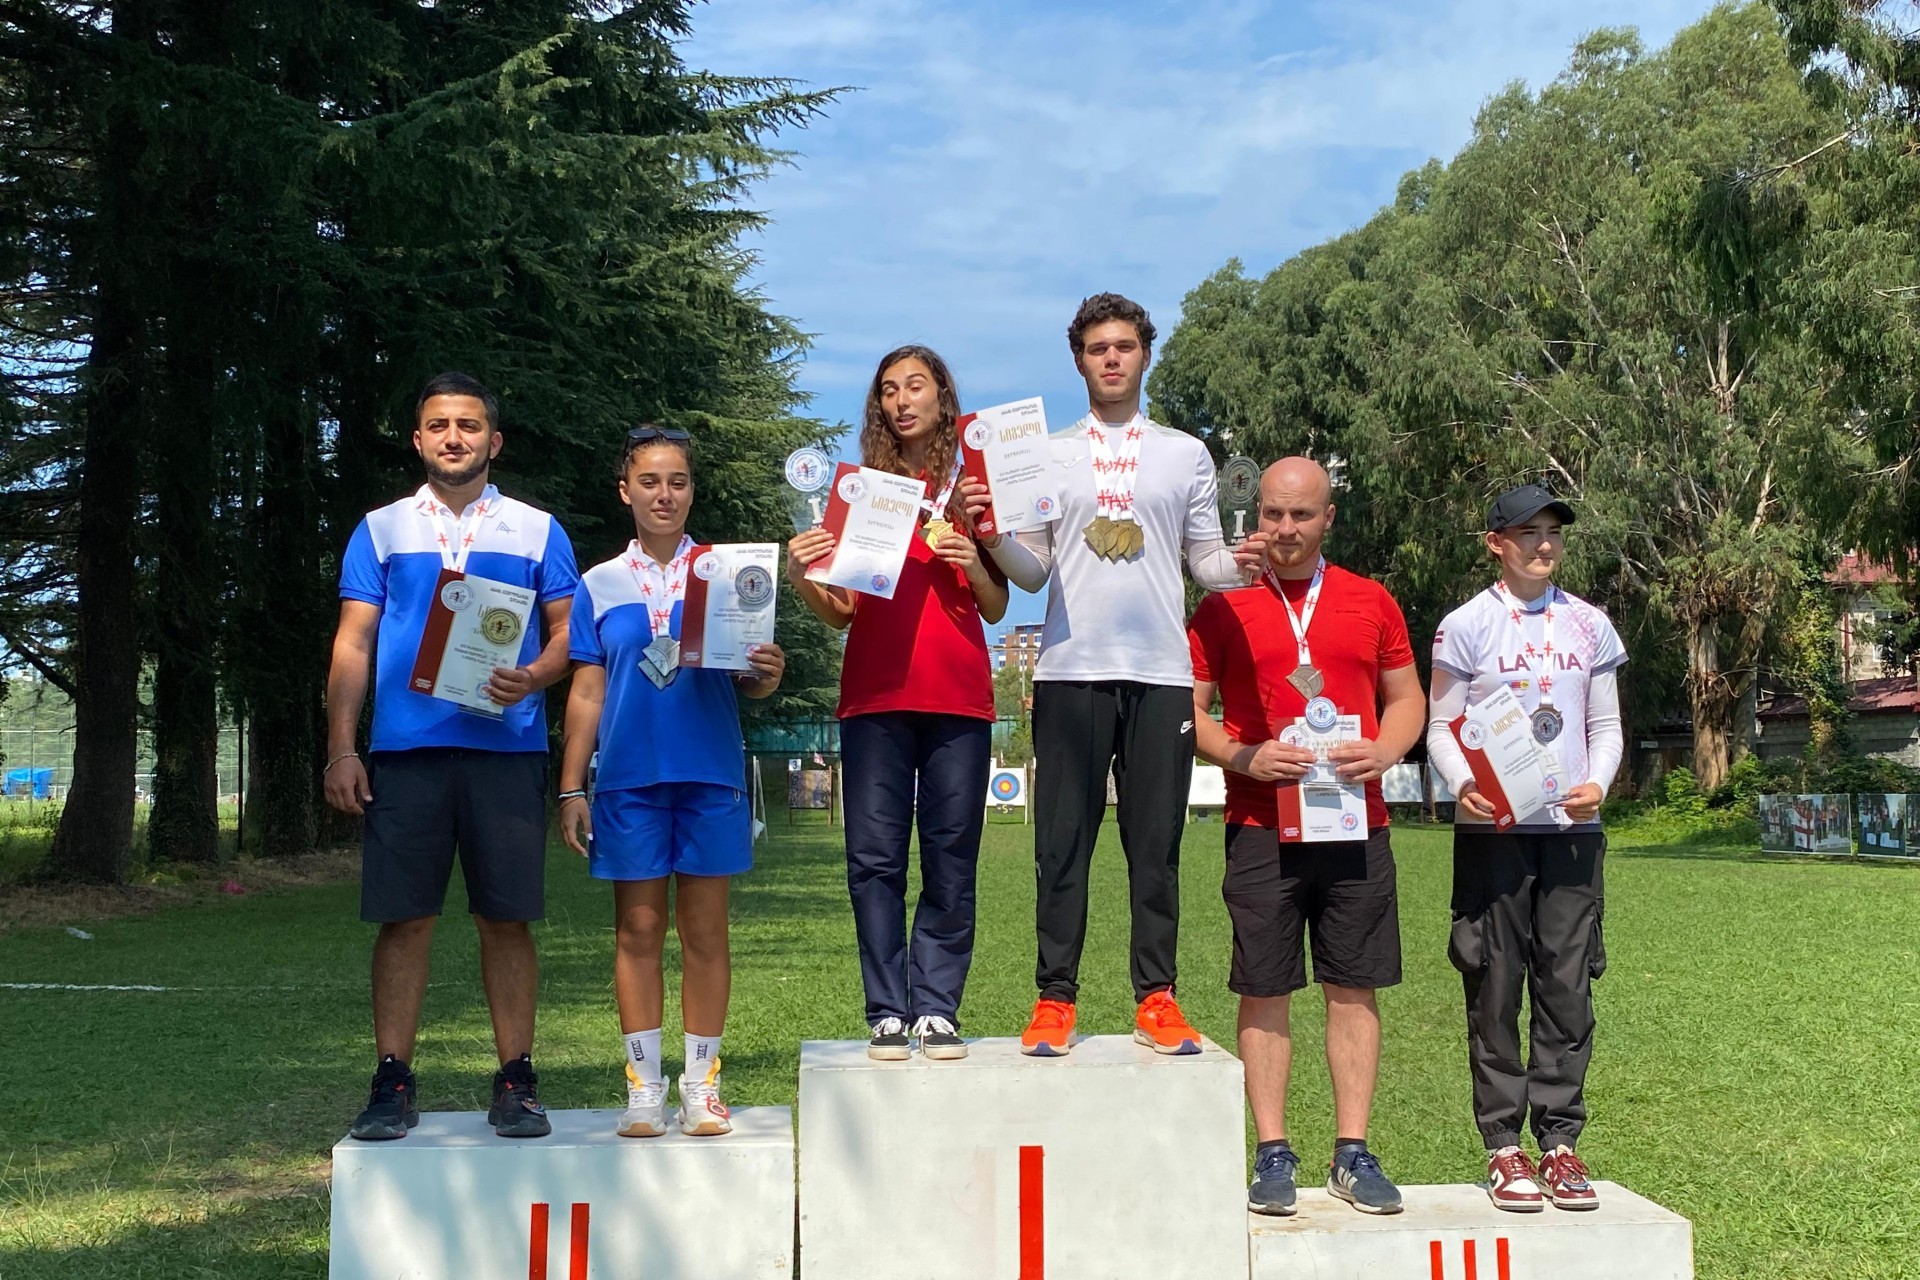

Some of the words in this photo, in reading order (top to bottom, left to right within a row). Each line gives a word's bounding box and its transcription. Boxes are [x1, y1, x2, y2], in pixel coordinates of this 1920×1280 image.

[999, 421, 1042, 443] სიგელი
[1498, 652, 1583, 673] LAIA
[792, 760, 798, 770] 3
